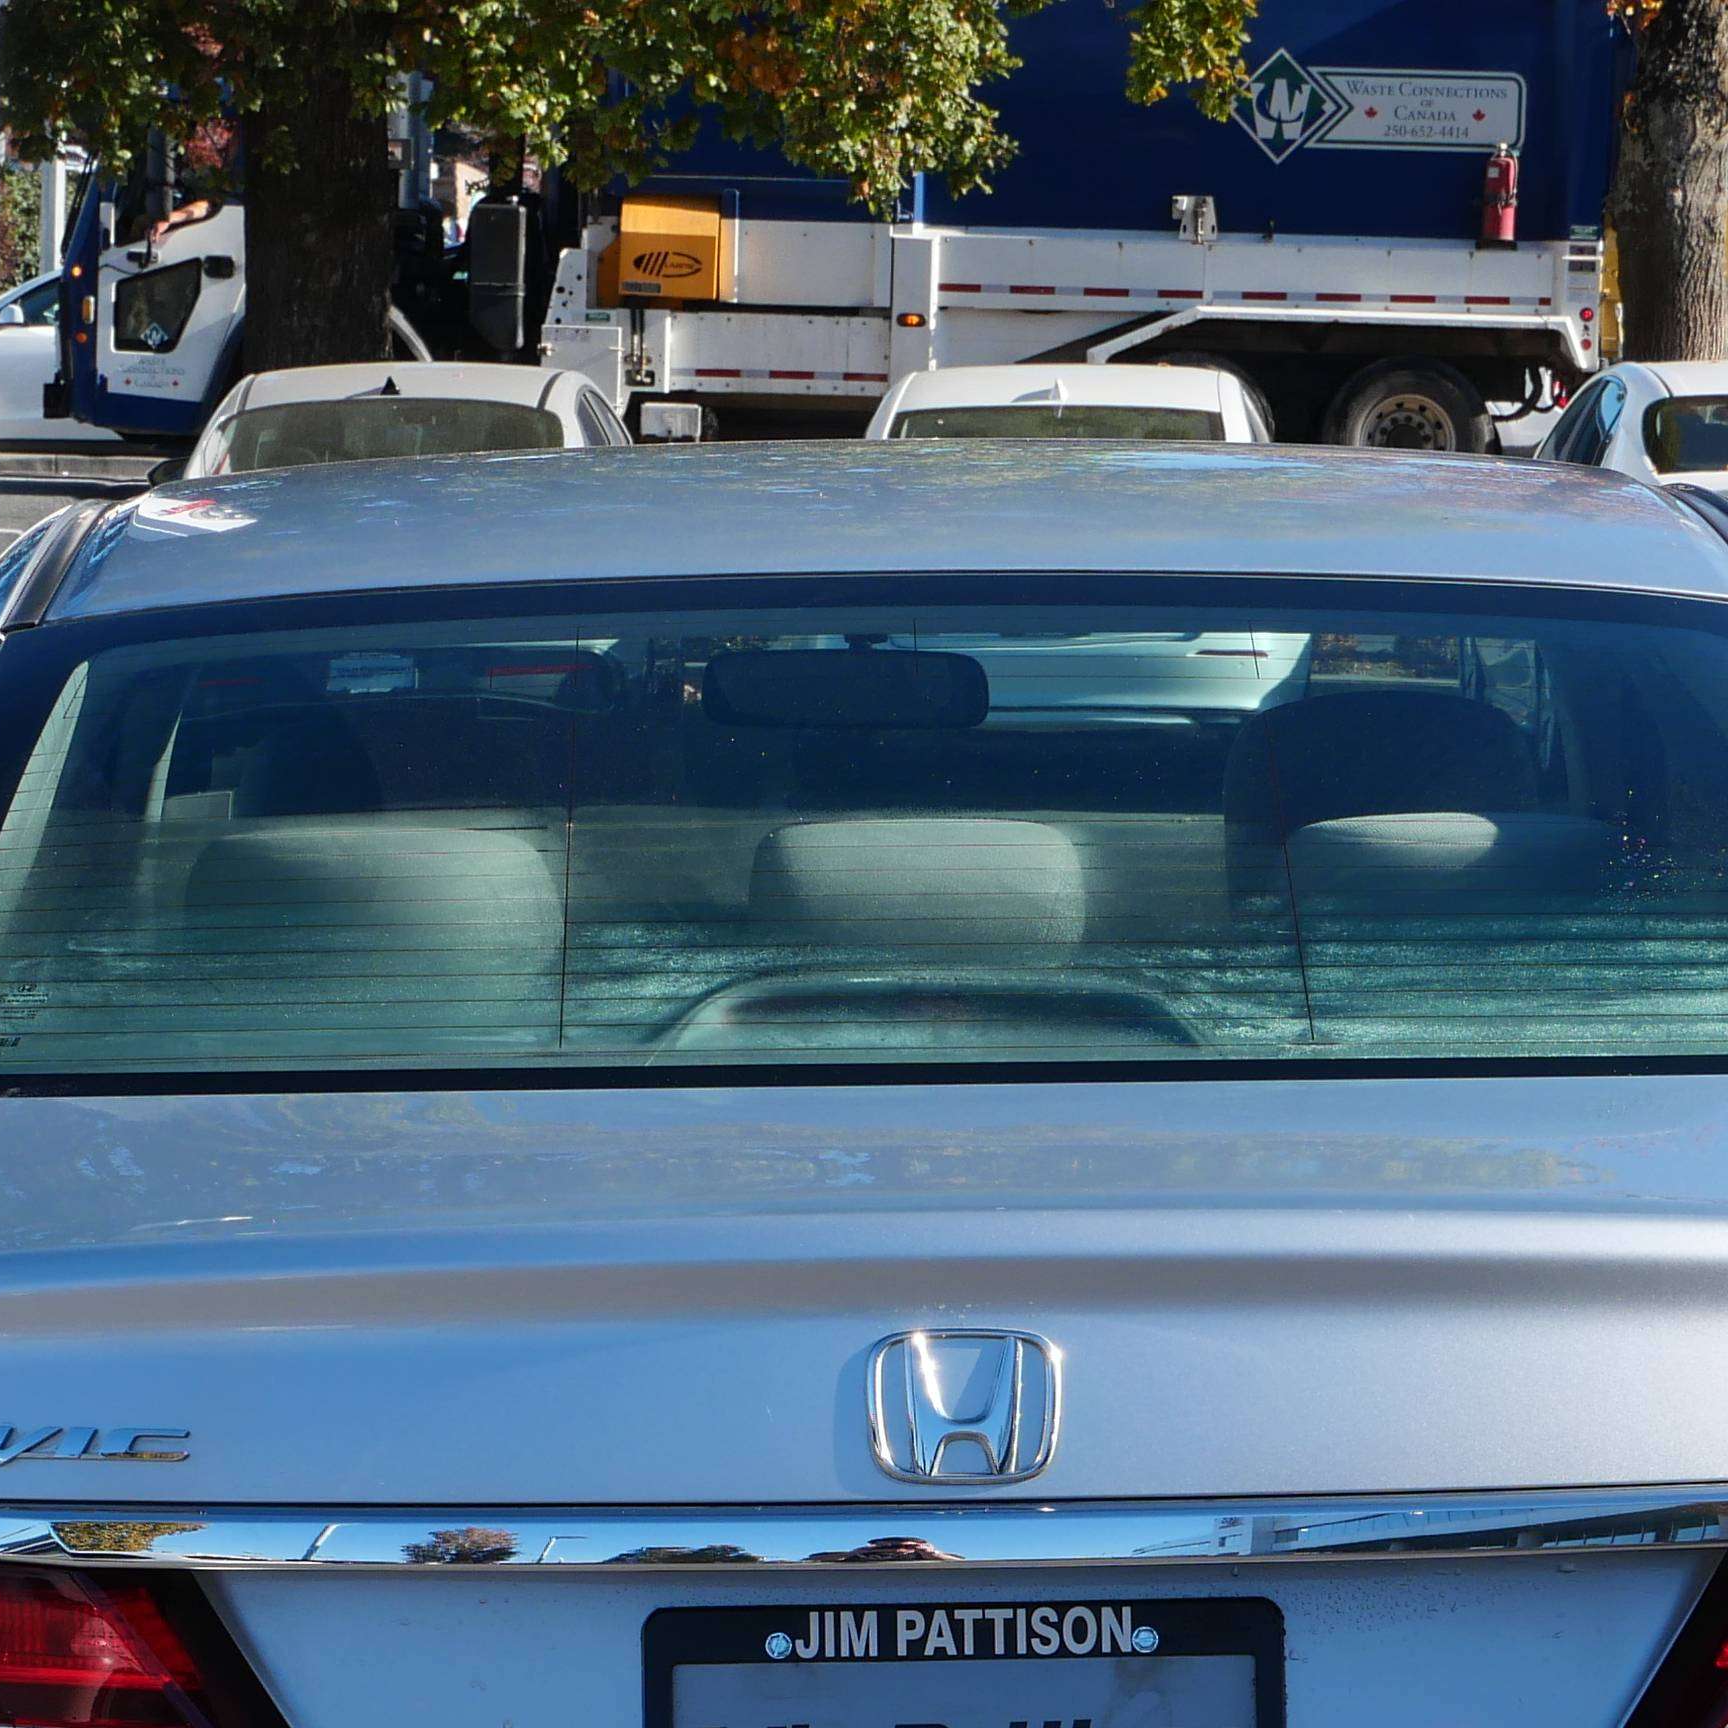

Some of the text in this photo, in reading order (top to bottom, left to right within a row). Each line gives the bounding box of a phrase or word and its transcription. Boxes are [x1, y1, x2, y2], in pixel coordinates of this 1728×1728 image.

[1346, 79, 1508, 100] WASTE CONNECTIONS
[1394, 105, 1456, 122] CANADA
[795, 1606, 1133, 1659] JIM PATTISON
